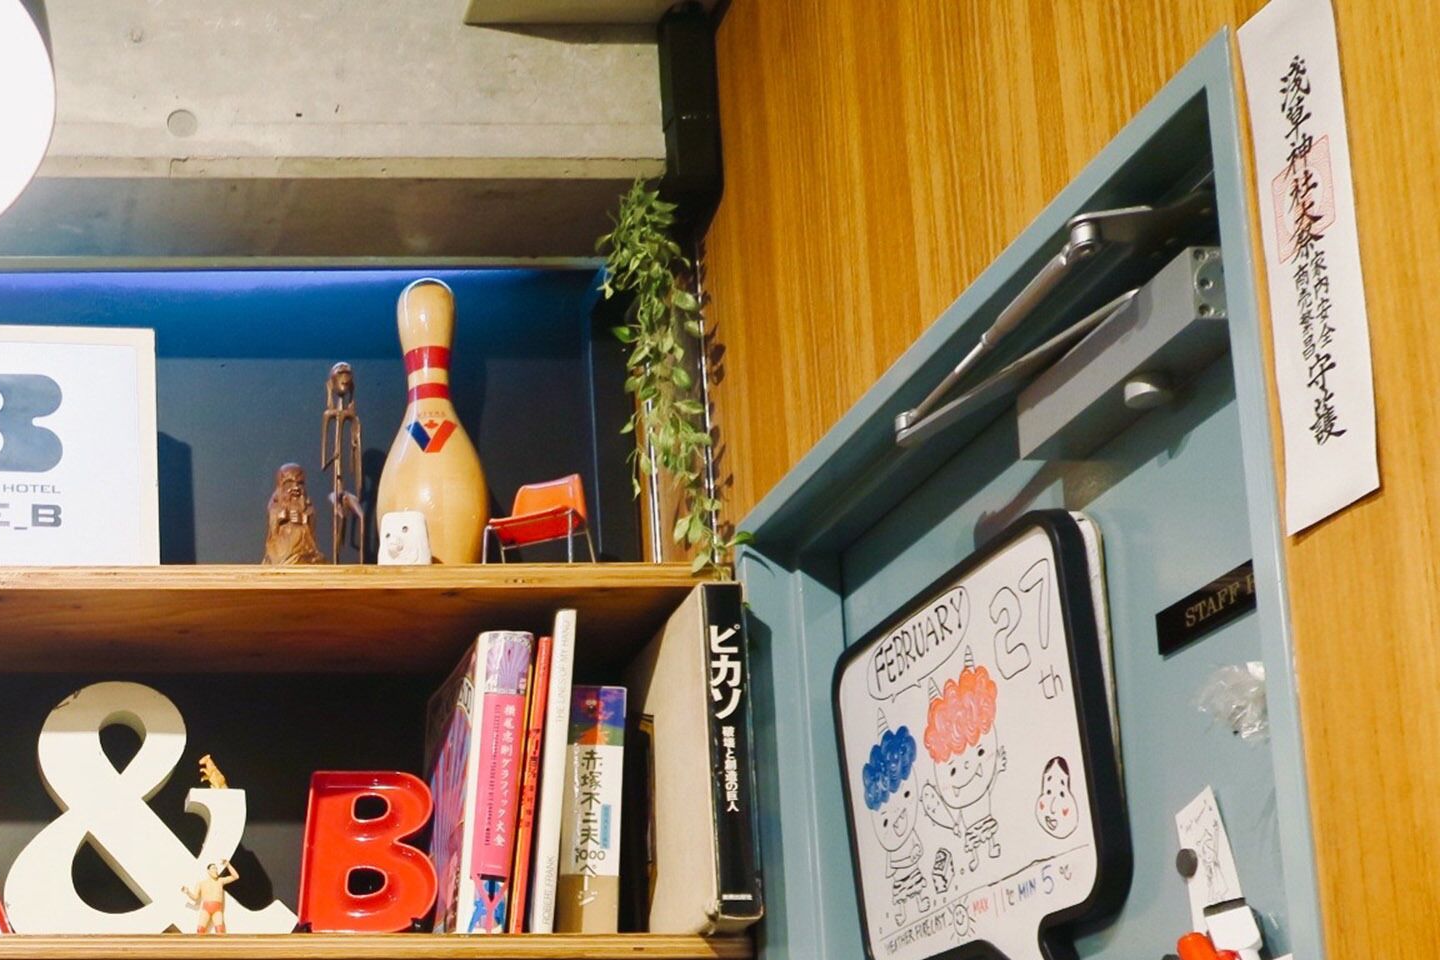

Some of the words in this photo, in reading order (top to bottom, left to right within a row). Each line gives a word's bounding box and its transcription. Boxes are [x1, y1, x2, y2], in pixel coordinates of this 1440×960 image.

[3, 483, 61, 494] HOTEL
[874, 587, 965, 684] FEBRUARY
[1184, 582, 1239, 629] STAFF
[709, 624, 742, 719] ピカソ
[297, 770, 437, 933] B
[1018, 879, 1036, 901] MIN
[1041, 865, 1054, 895] 5
